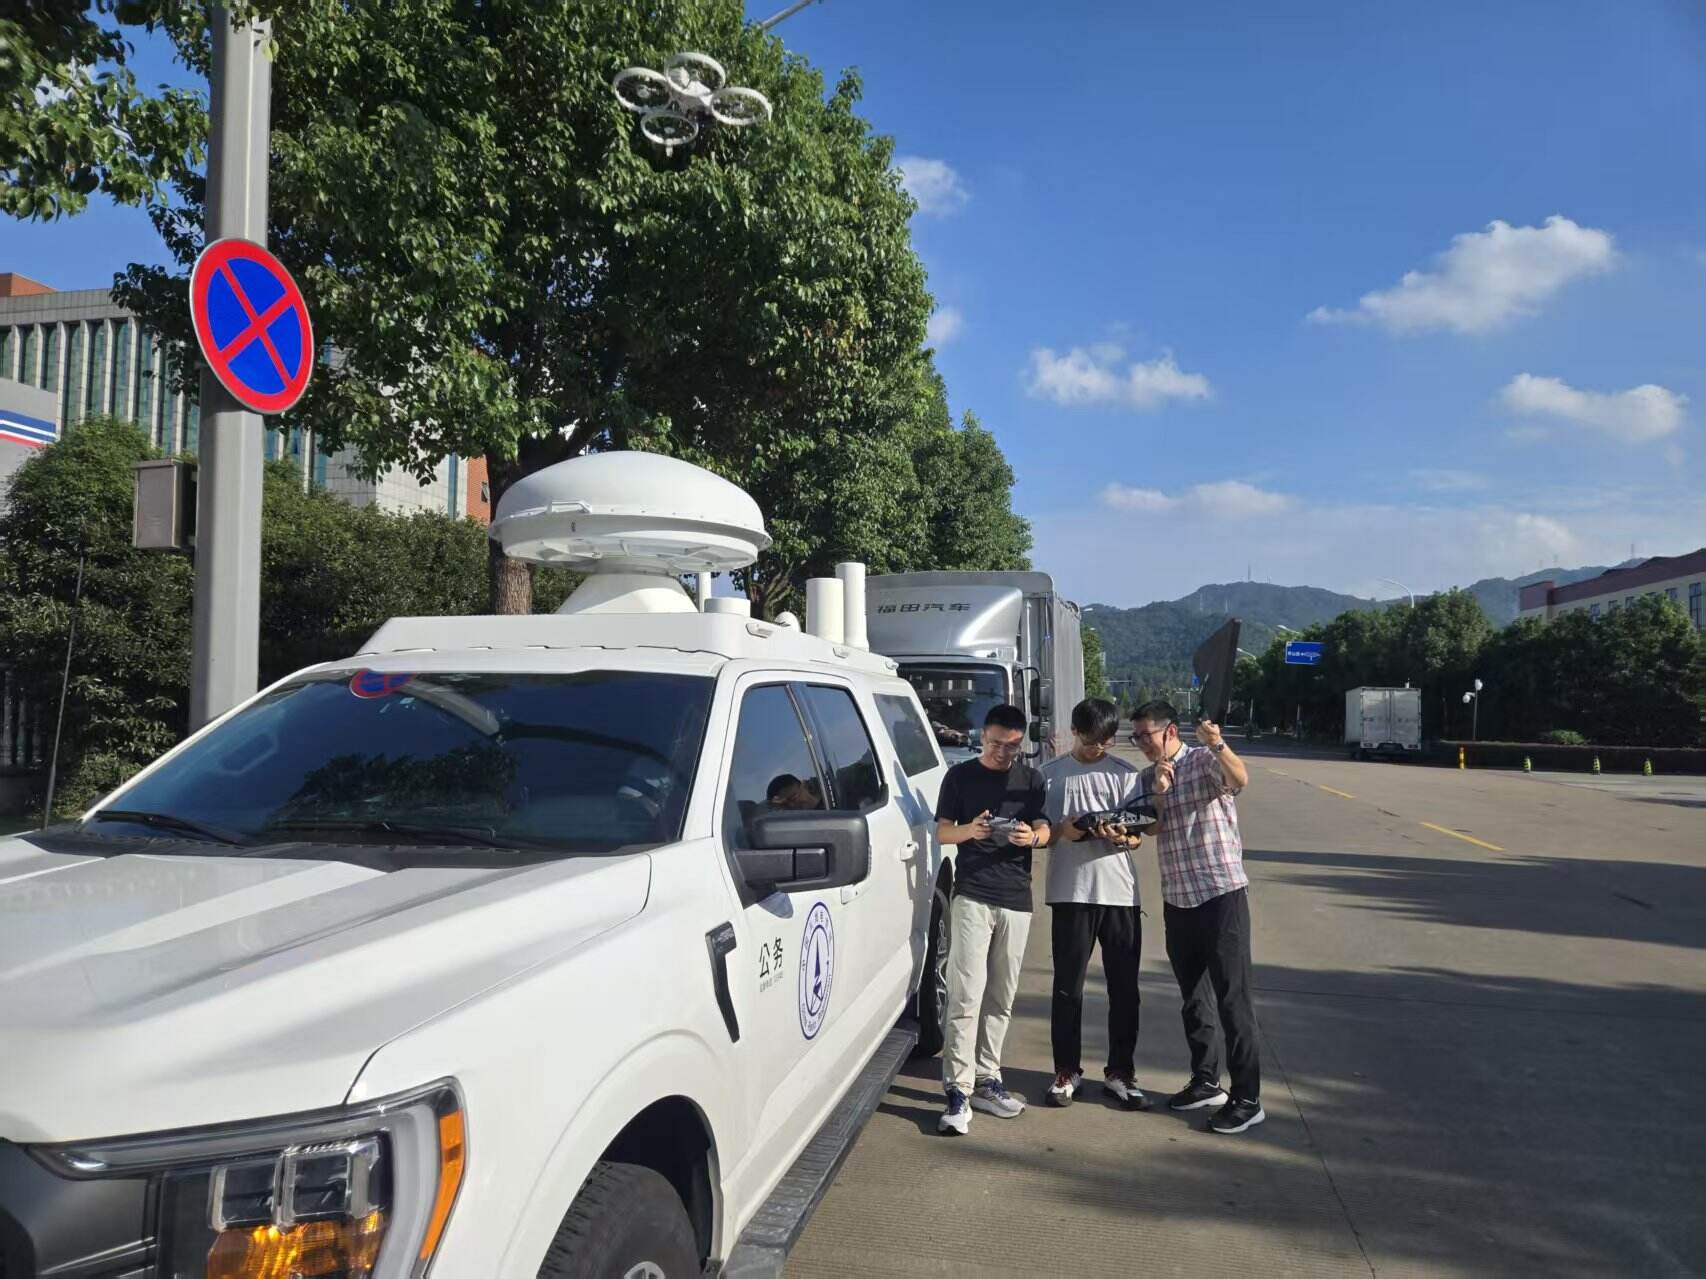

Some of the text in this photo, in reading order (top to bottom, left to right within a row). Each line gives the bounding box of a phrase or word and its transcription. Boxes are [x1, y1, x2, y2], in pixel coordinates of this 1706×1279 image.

[877, 603, 971, 614] 福田汽车
[759, 936, 783, 979] 公务
